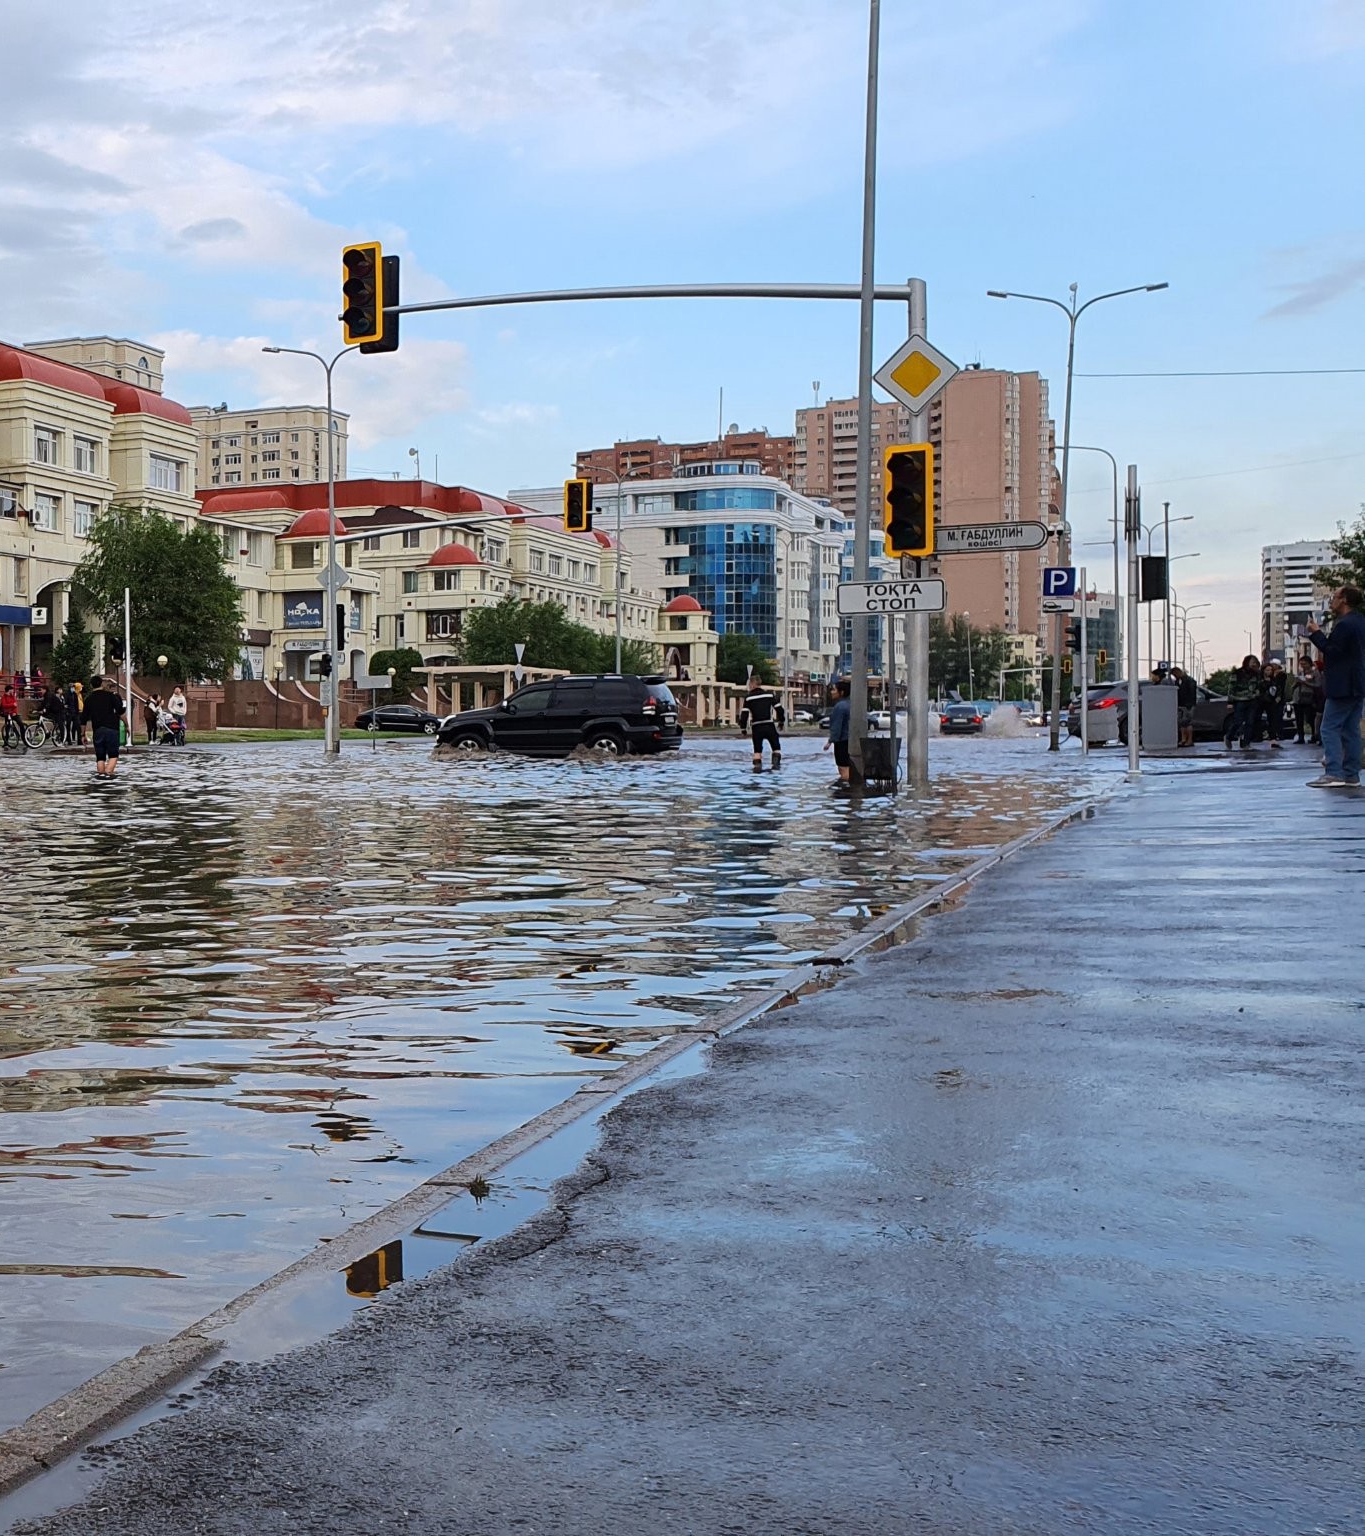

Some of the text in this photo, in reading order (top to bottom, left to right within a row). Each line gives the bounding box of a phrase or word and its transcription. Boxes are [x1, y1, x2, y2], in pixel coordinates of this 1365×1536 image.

[947, 531, 958, 543] М.
[1050, 570, 1068, 594] P
[863, 583, 923, 598] ТОҚТА
[866, 597, 916, 611] СТОП
